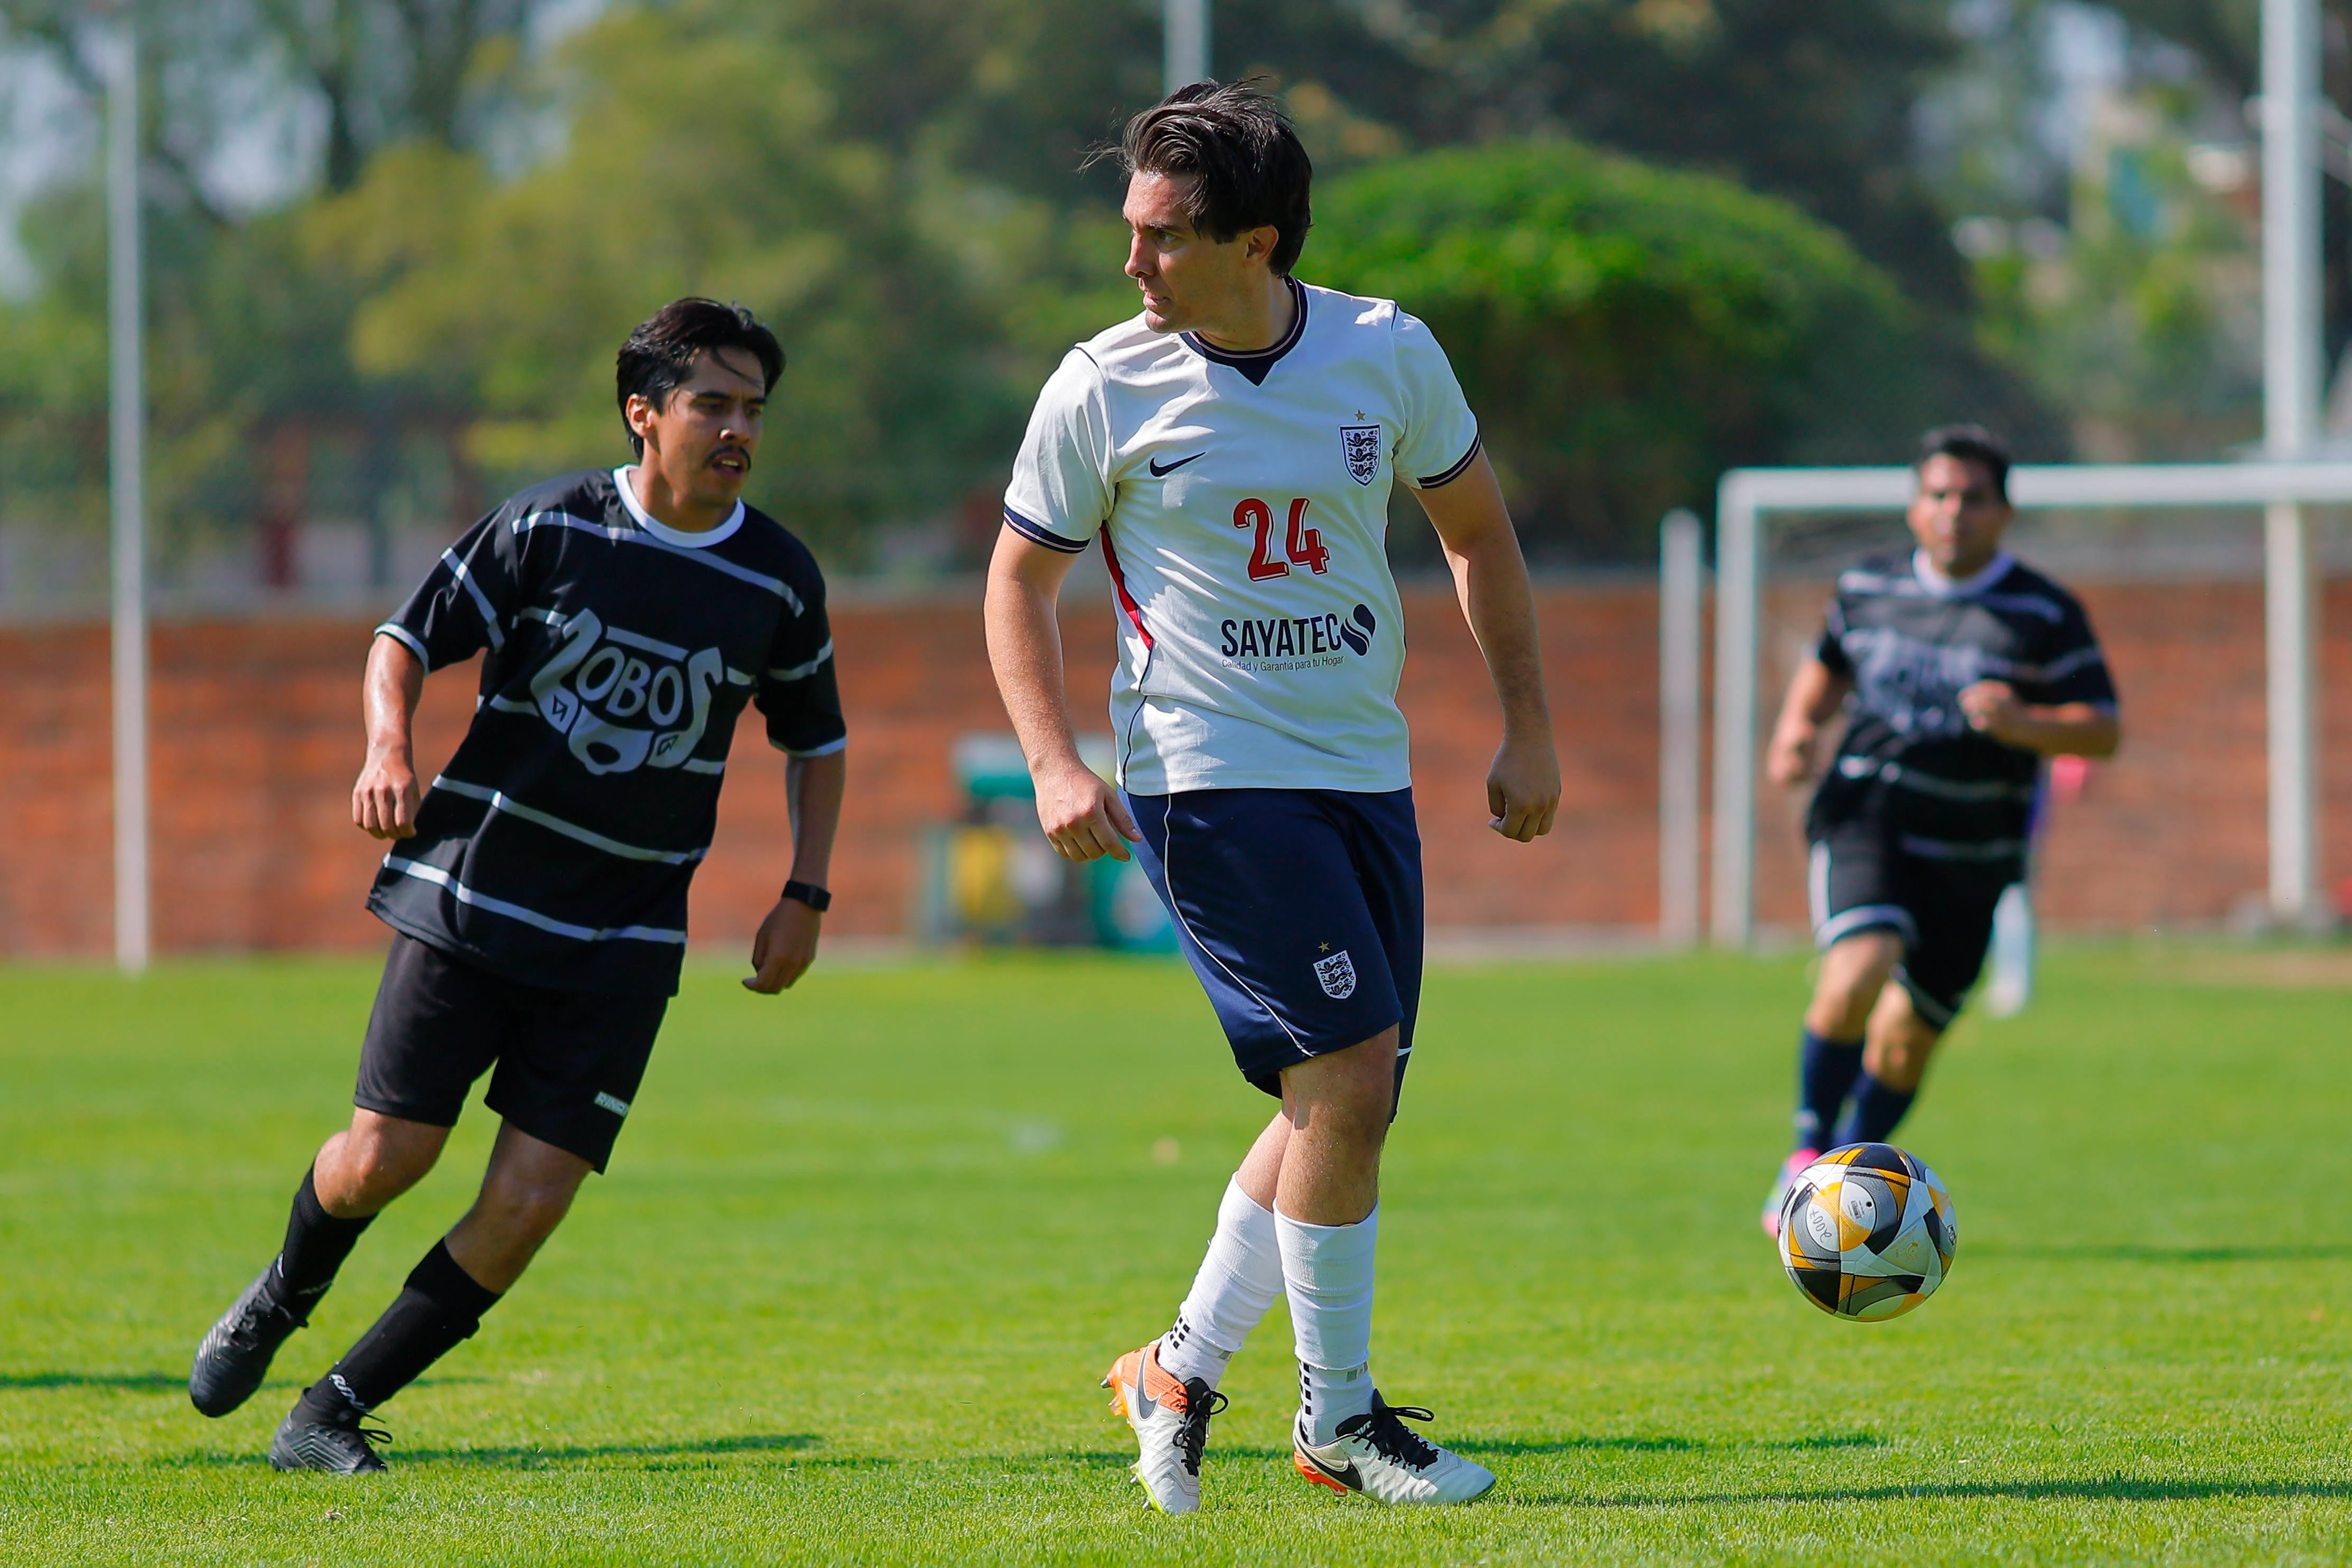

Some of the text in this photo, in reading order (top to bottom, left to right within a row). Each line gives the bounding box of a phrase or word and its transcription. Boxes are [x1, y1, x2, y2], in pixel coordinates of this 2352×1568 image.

[1233, 497, 1330, 582] 24
[1220, 613, 1342, 657] SAYATEC
[1221, 655, 1344, 673] Calidad y Garantía para tu Hogar
[530, 608, 724, 769] LOBOS
